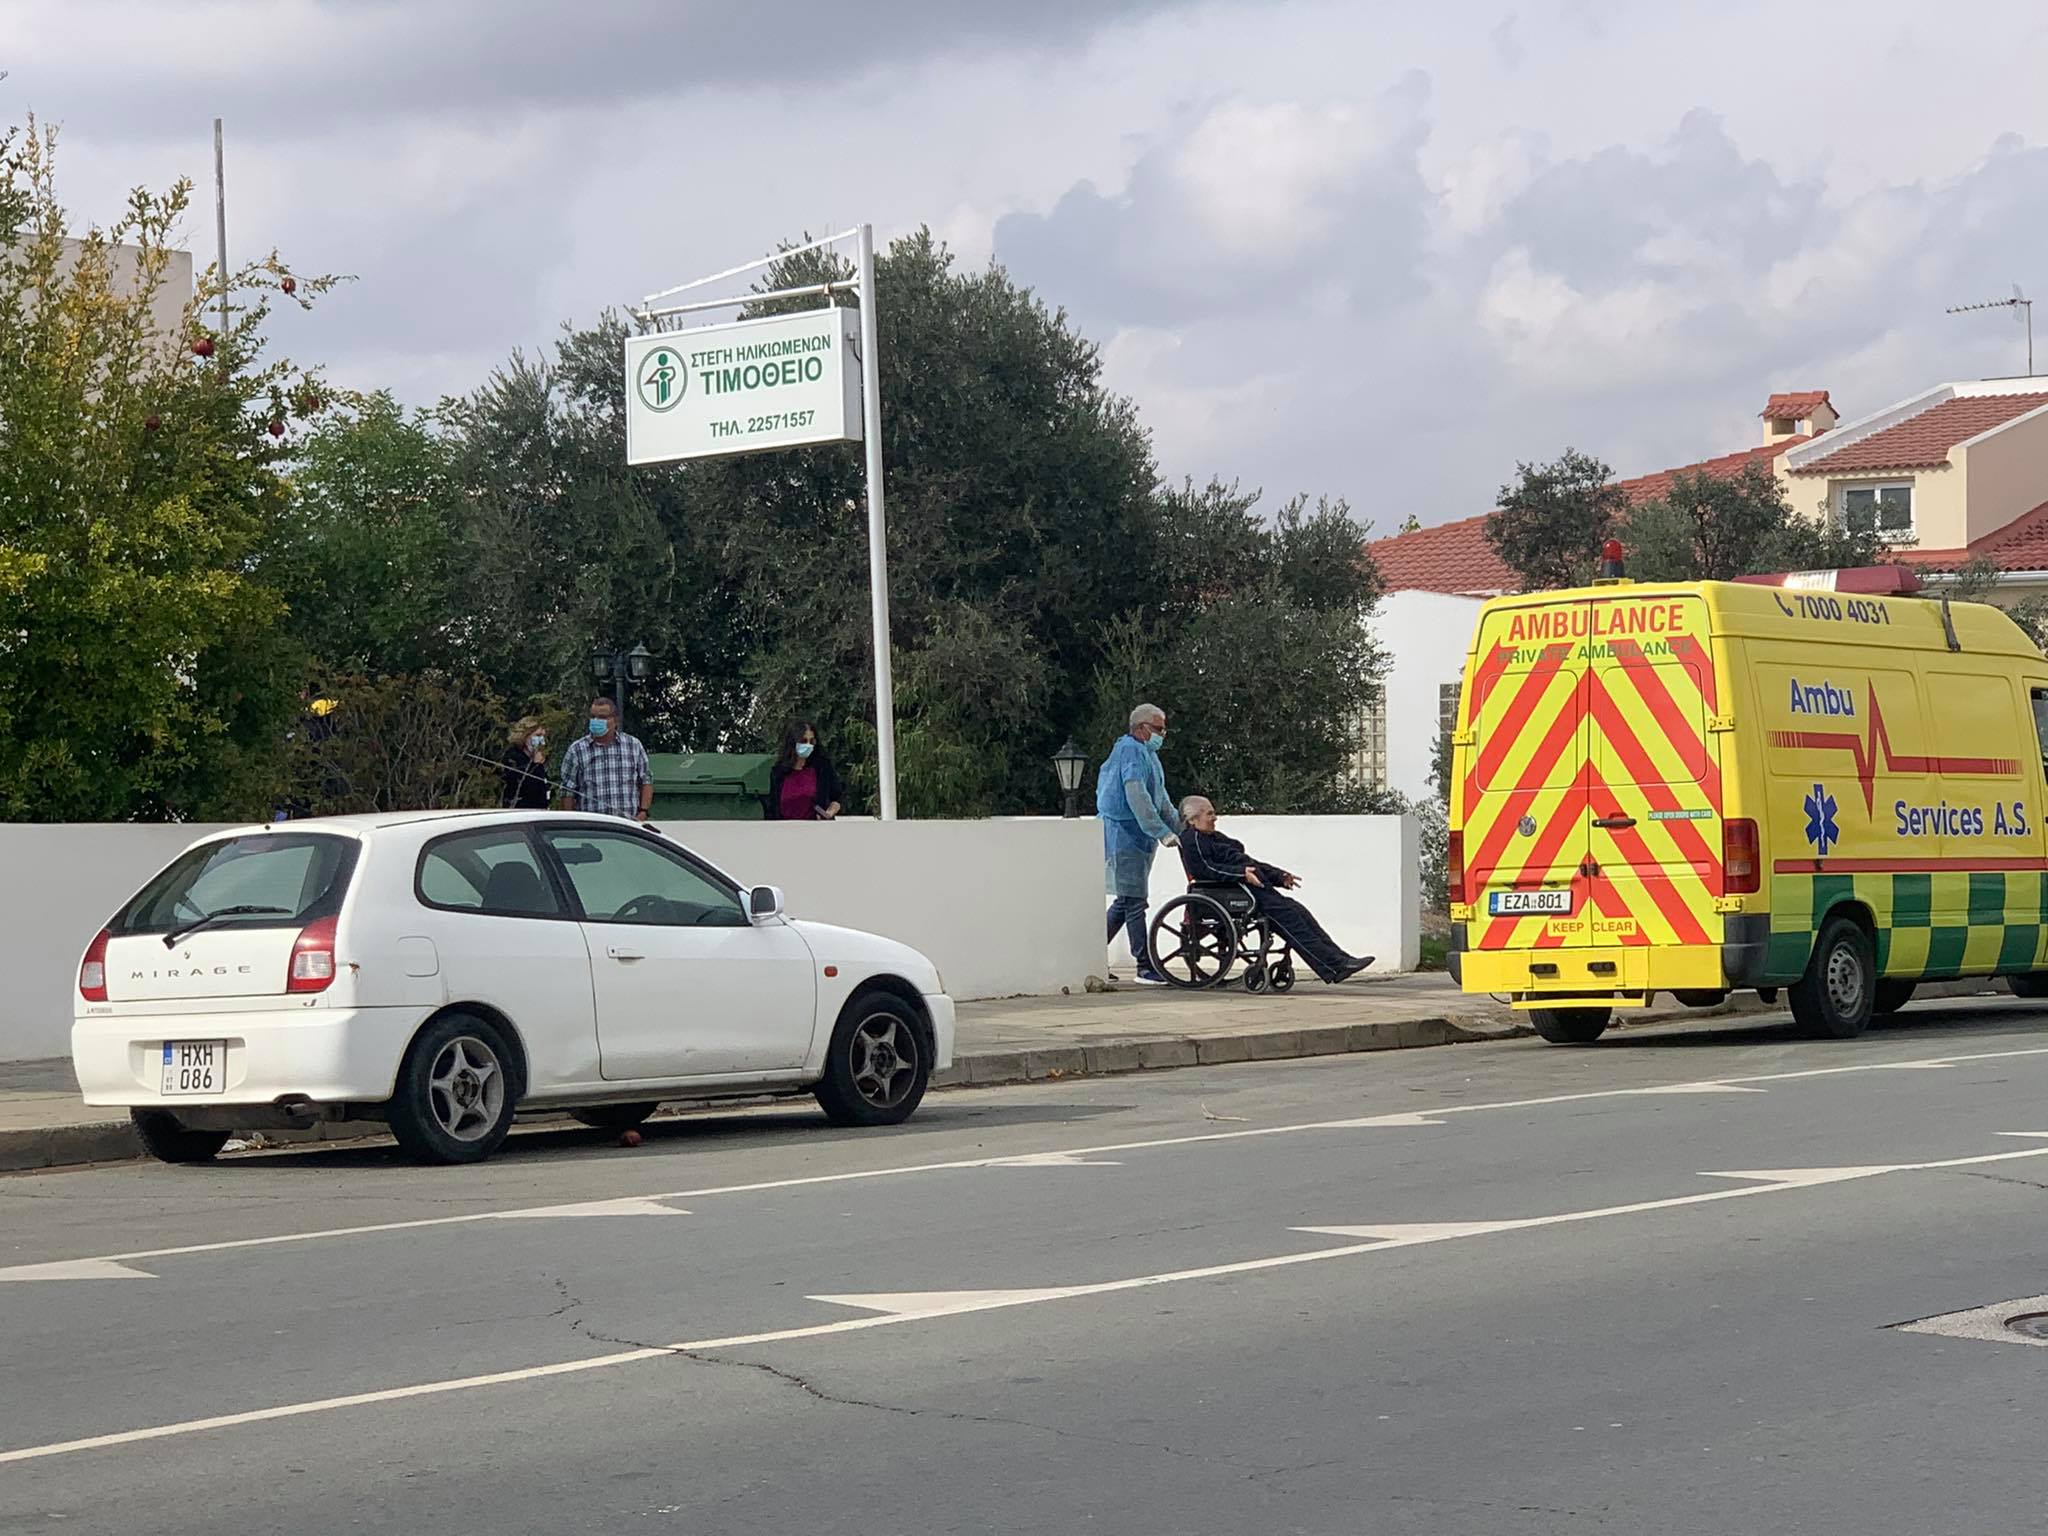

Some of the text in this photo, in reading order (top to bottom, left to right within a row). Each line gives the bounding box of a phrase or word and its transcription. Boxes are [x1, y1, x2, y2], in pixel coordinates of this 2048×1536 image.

[691, 334, 832, 369] ΣΤΕΓΗ ΗΛΙΚΙΩΜΕΝΩΝ
[700, 356, 823, 395] ΤΙΜΟΘΕΙΟ
[710, 410, 815, 438] ΤΗΛ. 22571557
[1508, 604, 1684, 641] AMBULANCE
[1793, 595, 1890, 625] 7000 4031
[1497, 641, 1691, 664] PRIVATE AMBULANCE
[1791, 678, 1855, 716] Ambu
[1894, 800, 2031, 836] Services A.S.
[1504, 893, 1562, 910] EZA 801
[1552, 921, 1633, 934] KEEP CLEAR
[131, 965, 251, 980] MIRAGE
[181, 1044, 213, 1067] HXH
[180, 1067, 213, 1090] 086
